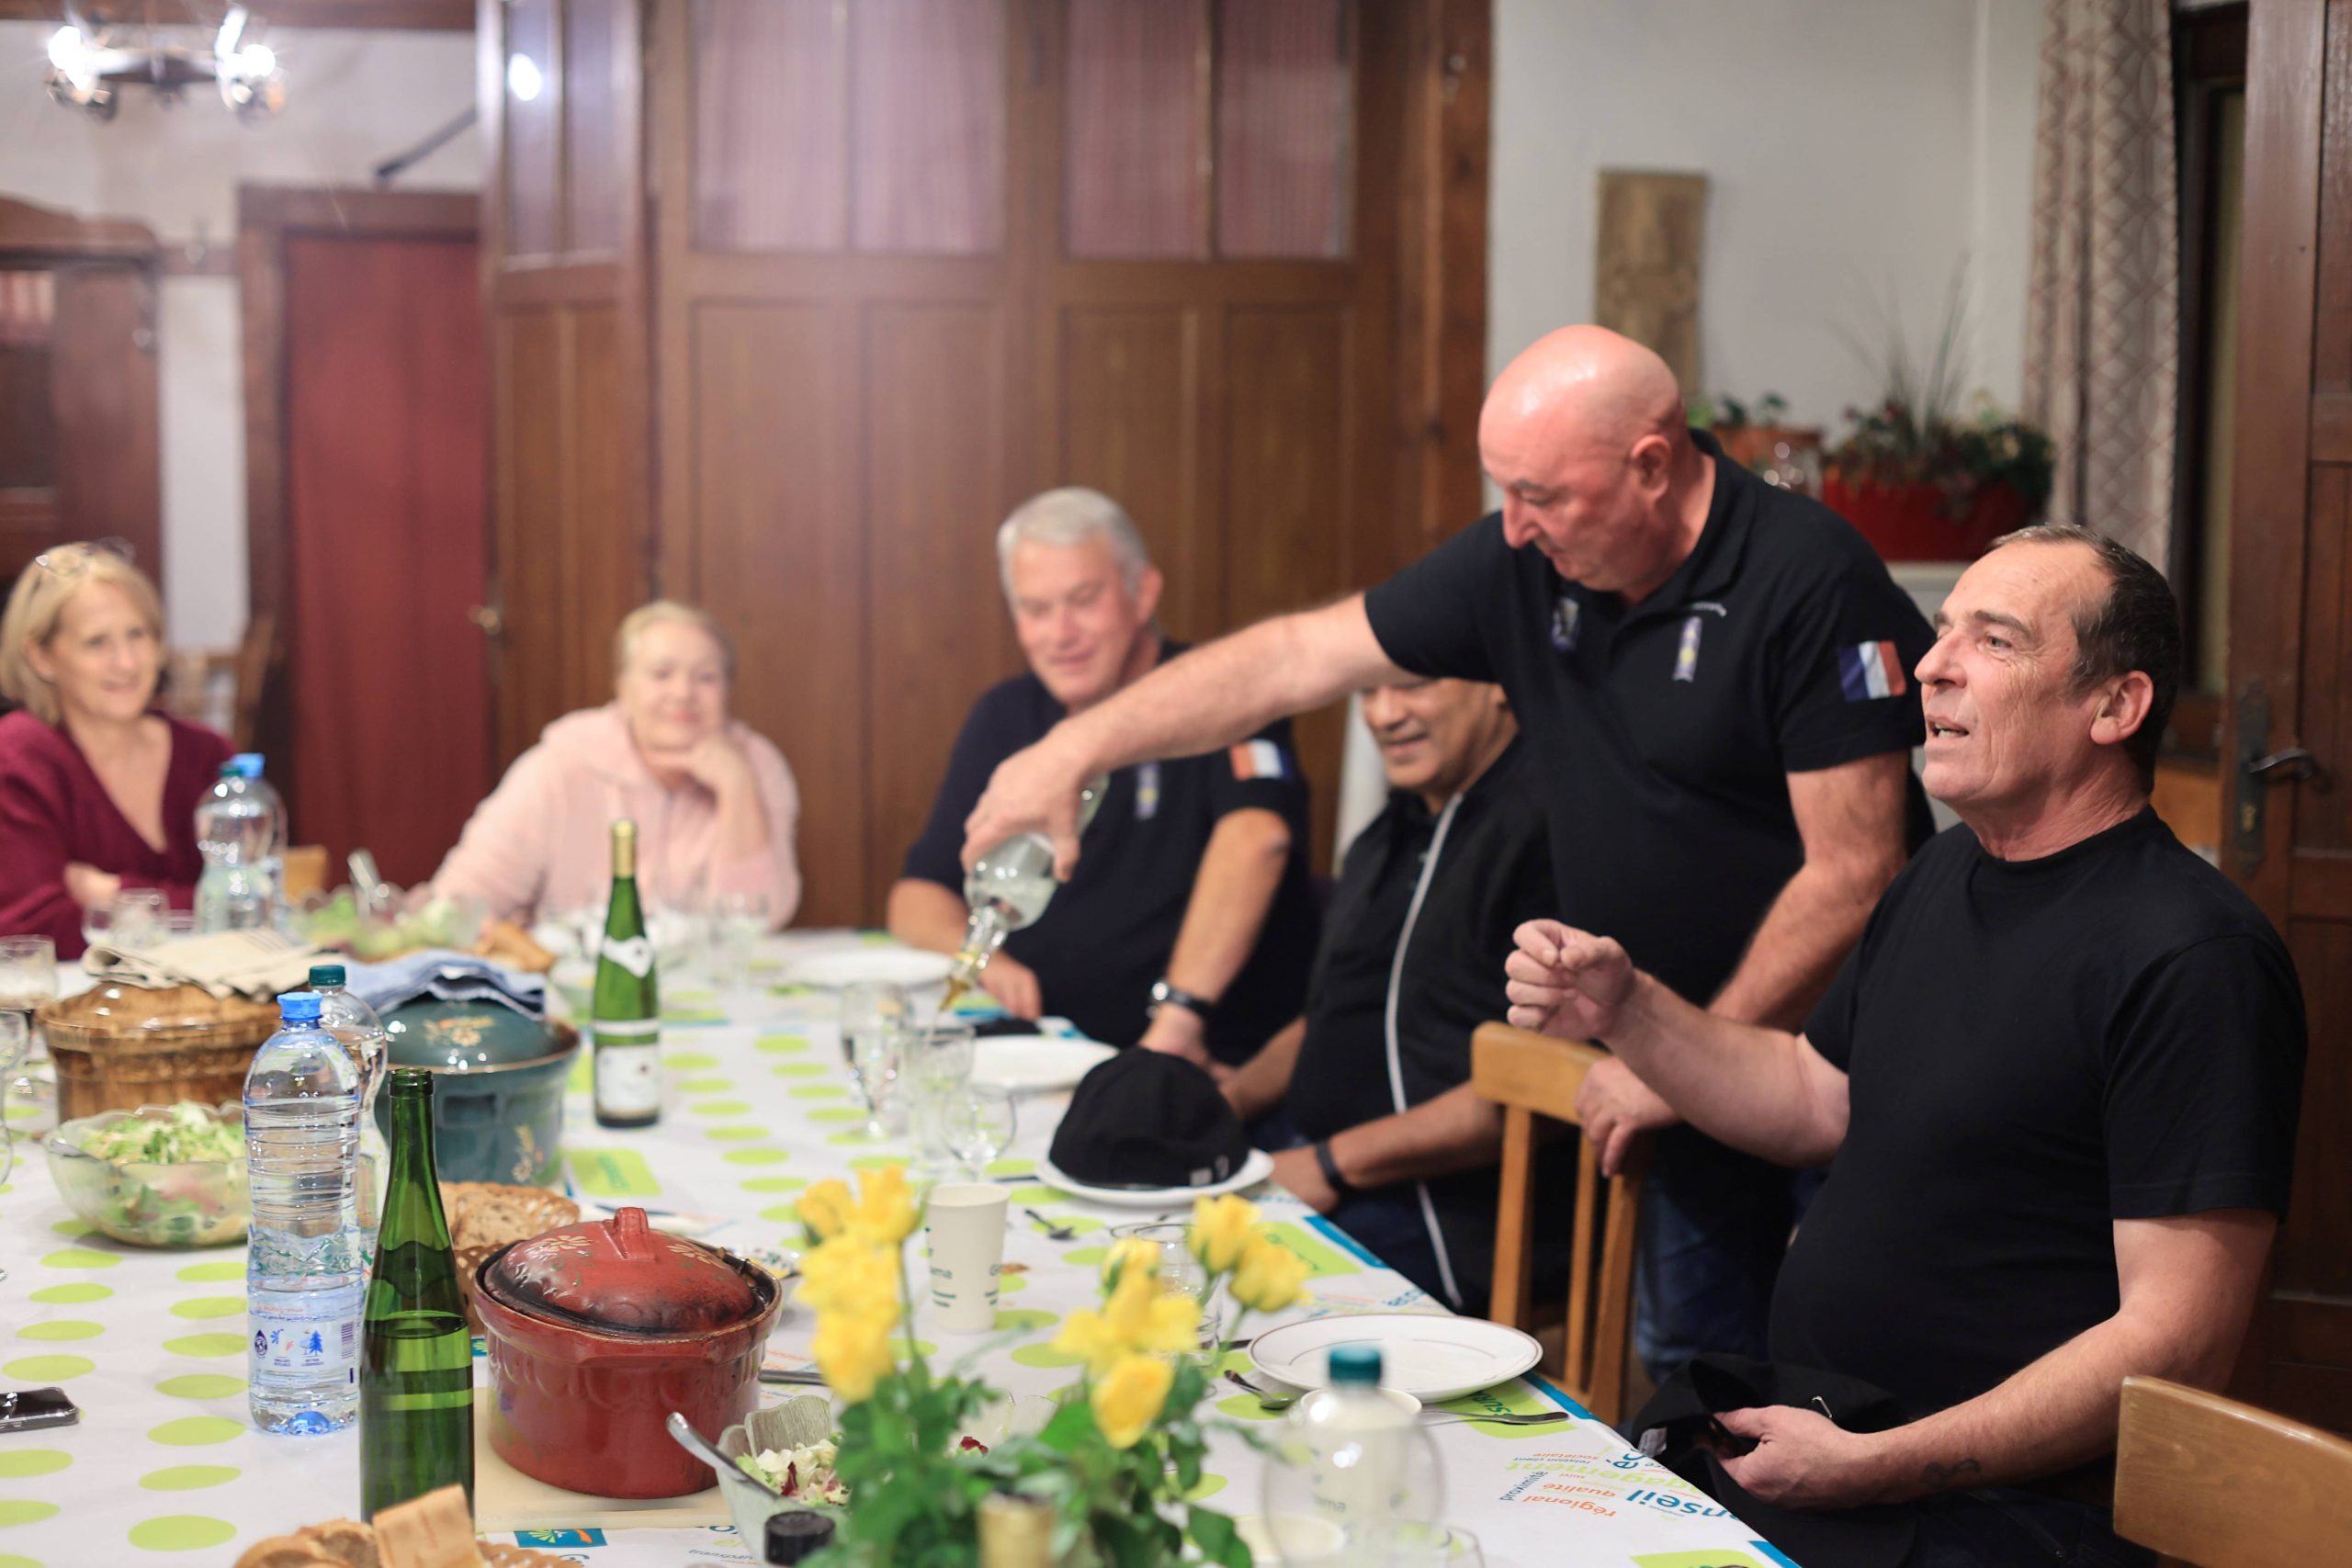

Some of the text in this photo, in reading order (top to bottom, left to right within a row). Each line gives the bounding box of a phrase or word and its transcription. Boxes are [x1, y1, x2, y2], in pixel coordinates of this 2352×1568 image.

[1504, 1461, 1703, 1496] gagement
[1544, 1483, 1616, 1498] qualité
[1522, 1495, 1618, 1517] régional
[1626, 1489, 1741, 1521] nseil
